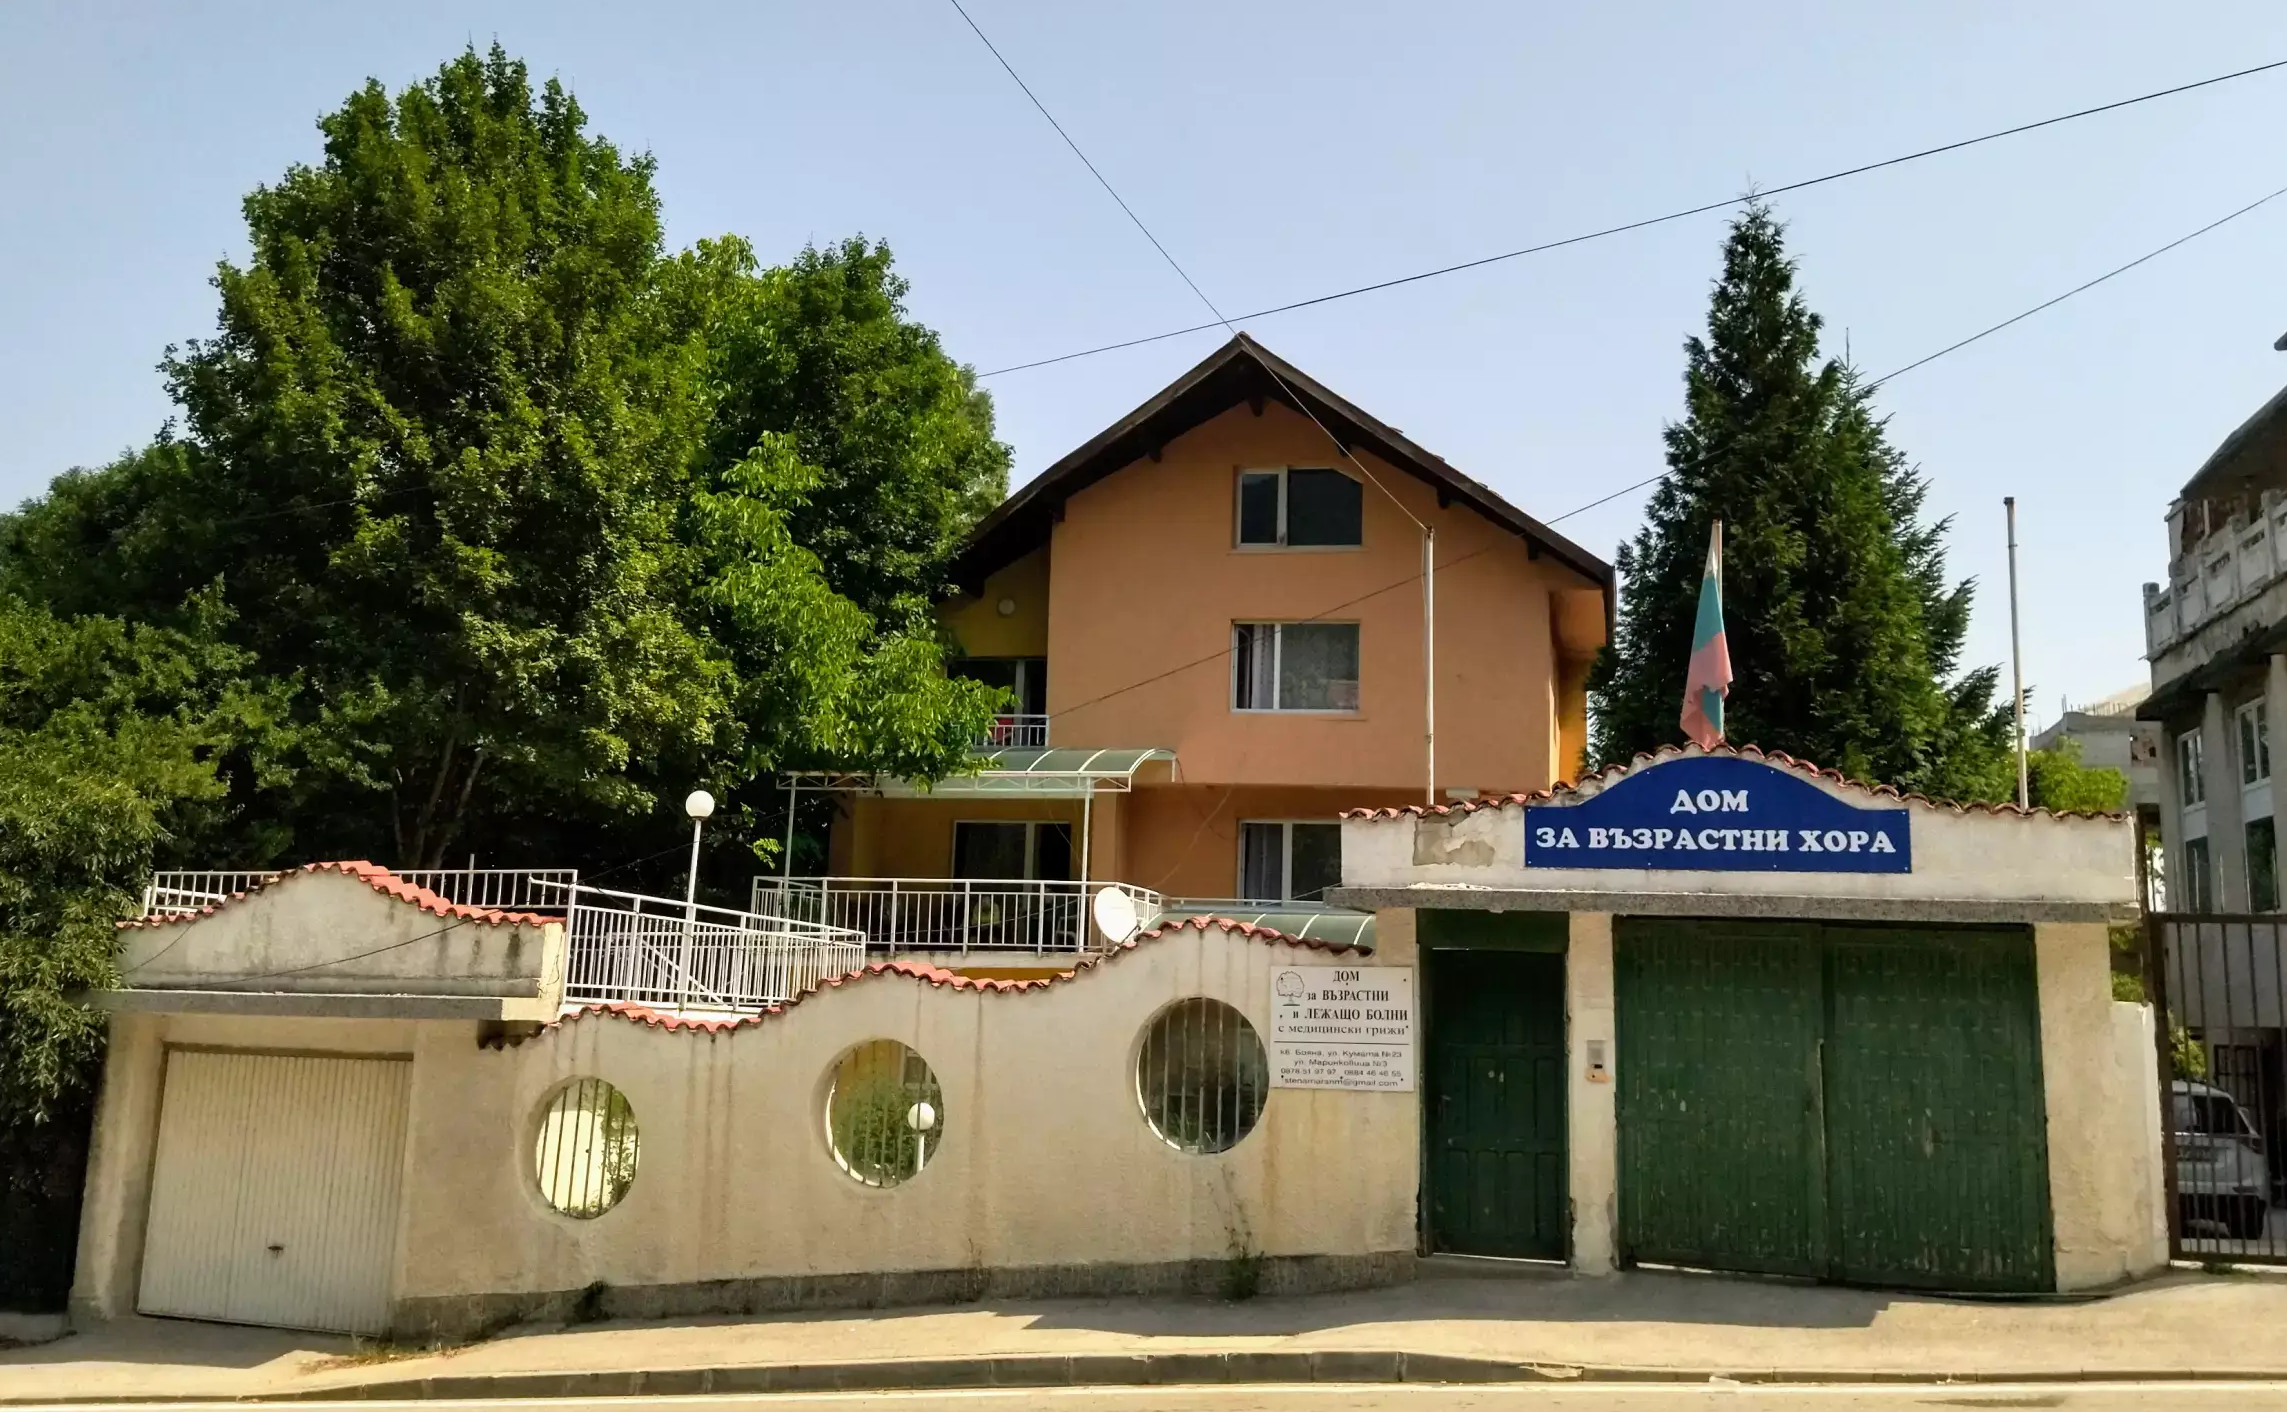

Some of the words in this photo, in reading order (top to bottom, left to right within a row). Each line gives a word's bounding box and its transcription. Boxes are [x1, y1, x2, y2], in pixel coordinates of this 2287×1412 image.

[1669, 789, 1750, 815] ДОМ
[1535, 827, 1580, 849] ЗА
[1588, 827, 1789, 851] ВЪЗРАСТНИ
[1798, 830, 1897, 853] ХОРА
[1333, 970, 1360, 983] ДОМ
[1307, 992, 1317, 1001] за
[1322, 990, 1389, 1002] ВЪЗРАСТНИ
[1293, 1011, 1299, 1019] и
[1305, 1008, 1361, 1021] ЛЕЖАЩО
[1366, 1009, 1408, 1021] БОЛНИ
[1278, 1025, 1285, 1033] с
[1288, 1025, 1362, 1035] медицински
[1366, 1026, 1405, 1037] грижи
